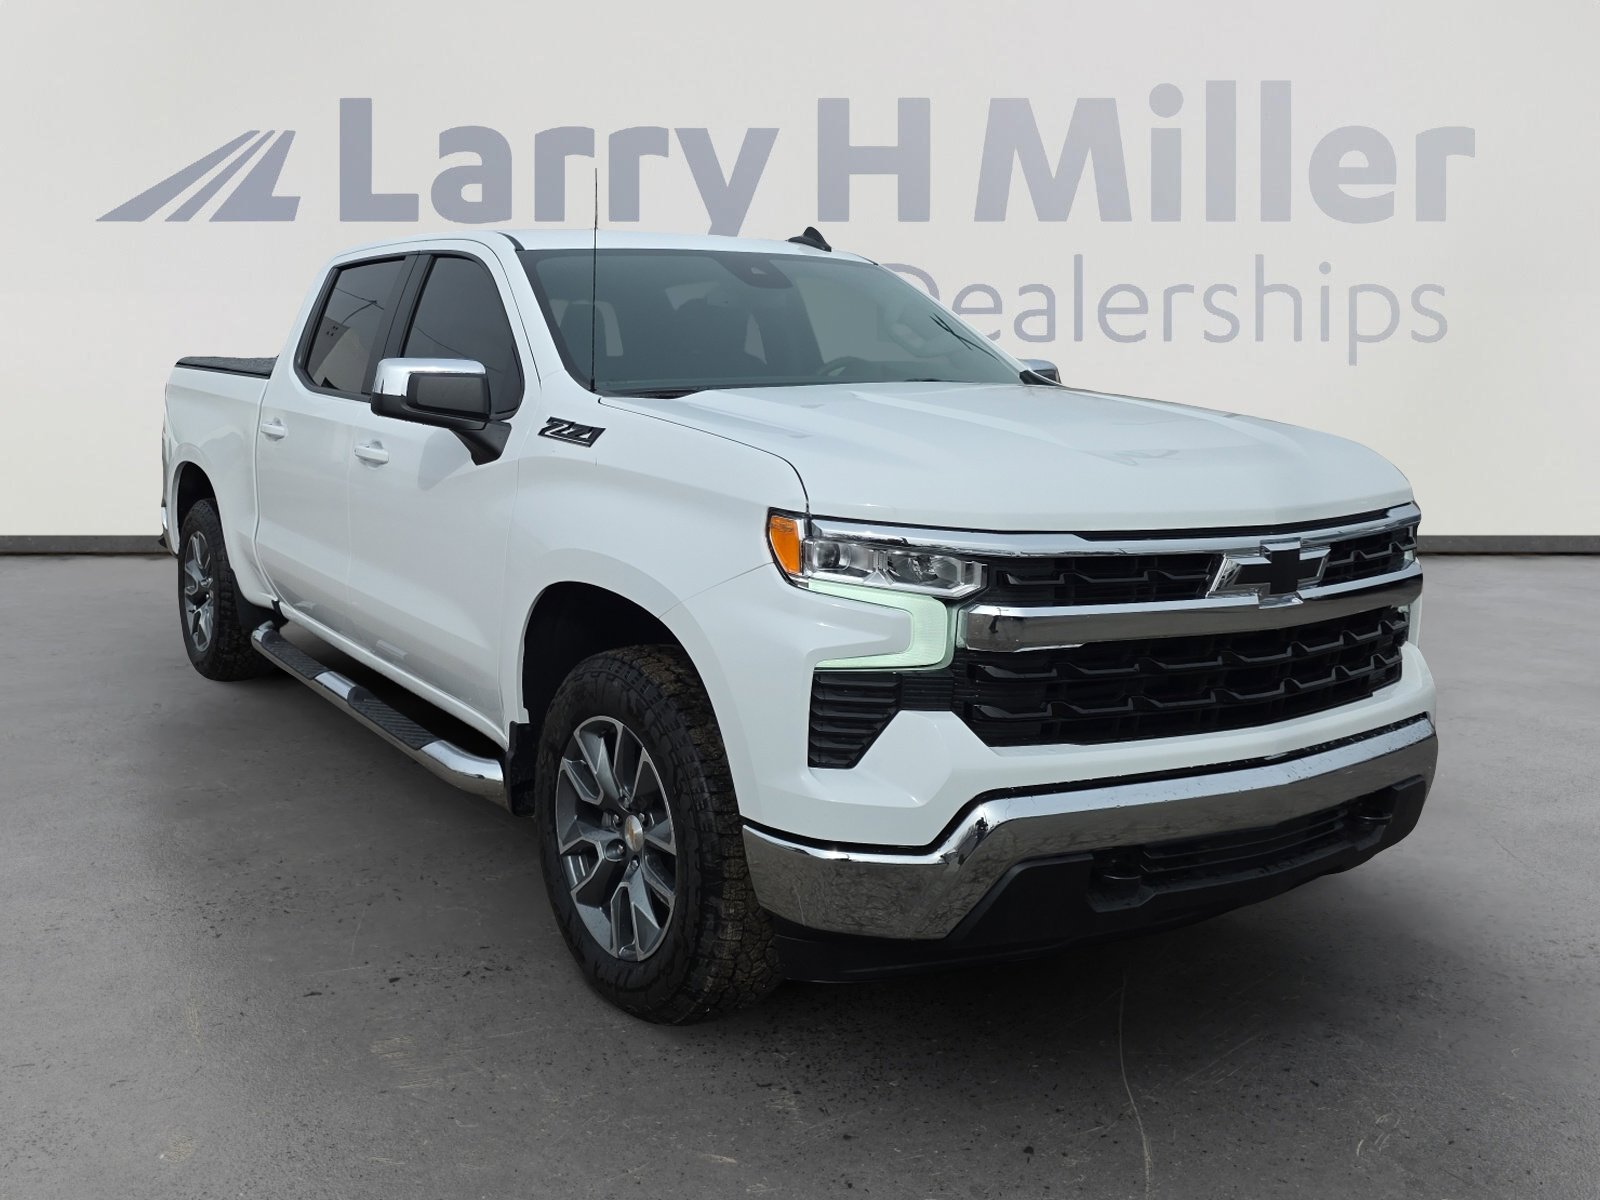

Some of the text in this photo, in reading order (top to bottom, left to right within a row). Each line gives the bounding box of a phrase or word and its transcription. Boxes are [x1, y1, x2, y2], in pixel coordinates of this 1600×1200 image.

[339, 80, 1475, 237] Larry H Miller
[538, 416, 606, 448] Z71
